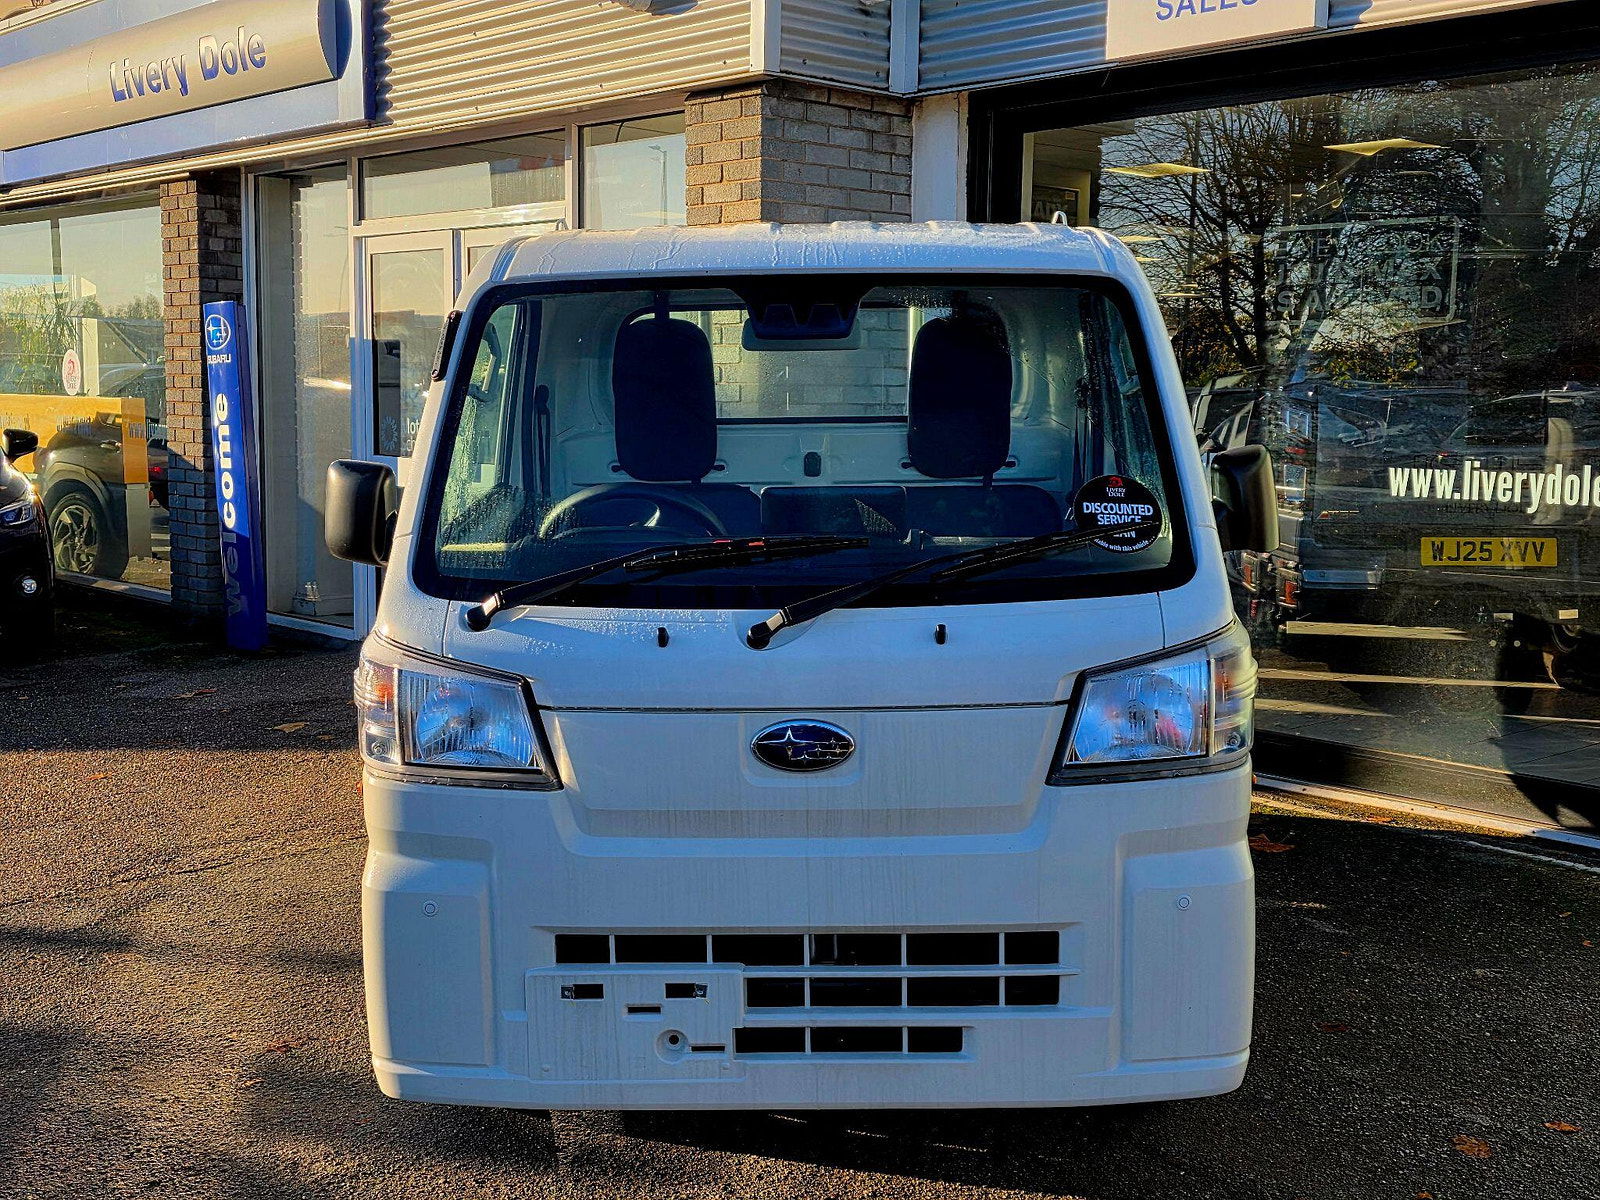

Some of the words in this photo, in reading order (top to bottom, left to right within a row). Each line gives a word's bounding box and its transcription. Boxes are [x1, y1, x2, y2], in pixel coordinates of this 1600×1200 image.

[109, 54, 189, 102] Livery
[198, 25, 267, 81] Dole
[215, 393, 242, 617] welcome
[1082, 501, 1154, 516] DISCOUNTED
[1097, 514, 1142, 525] SERVICE
[1431, 541, 1493, 562] WJ25
[1500, 540, 1545, 562] XVV
